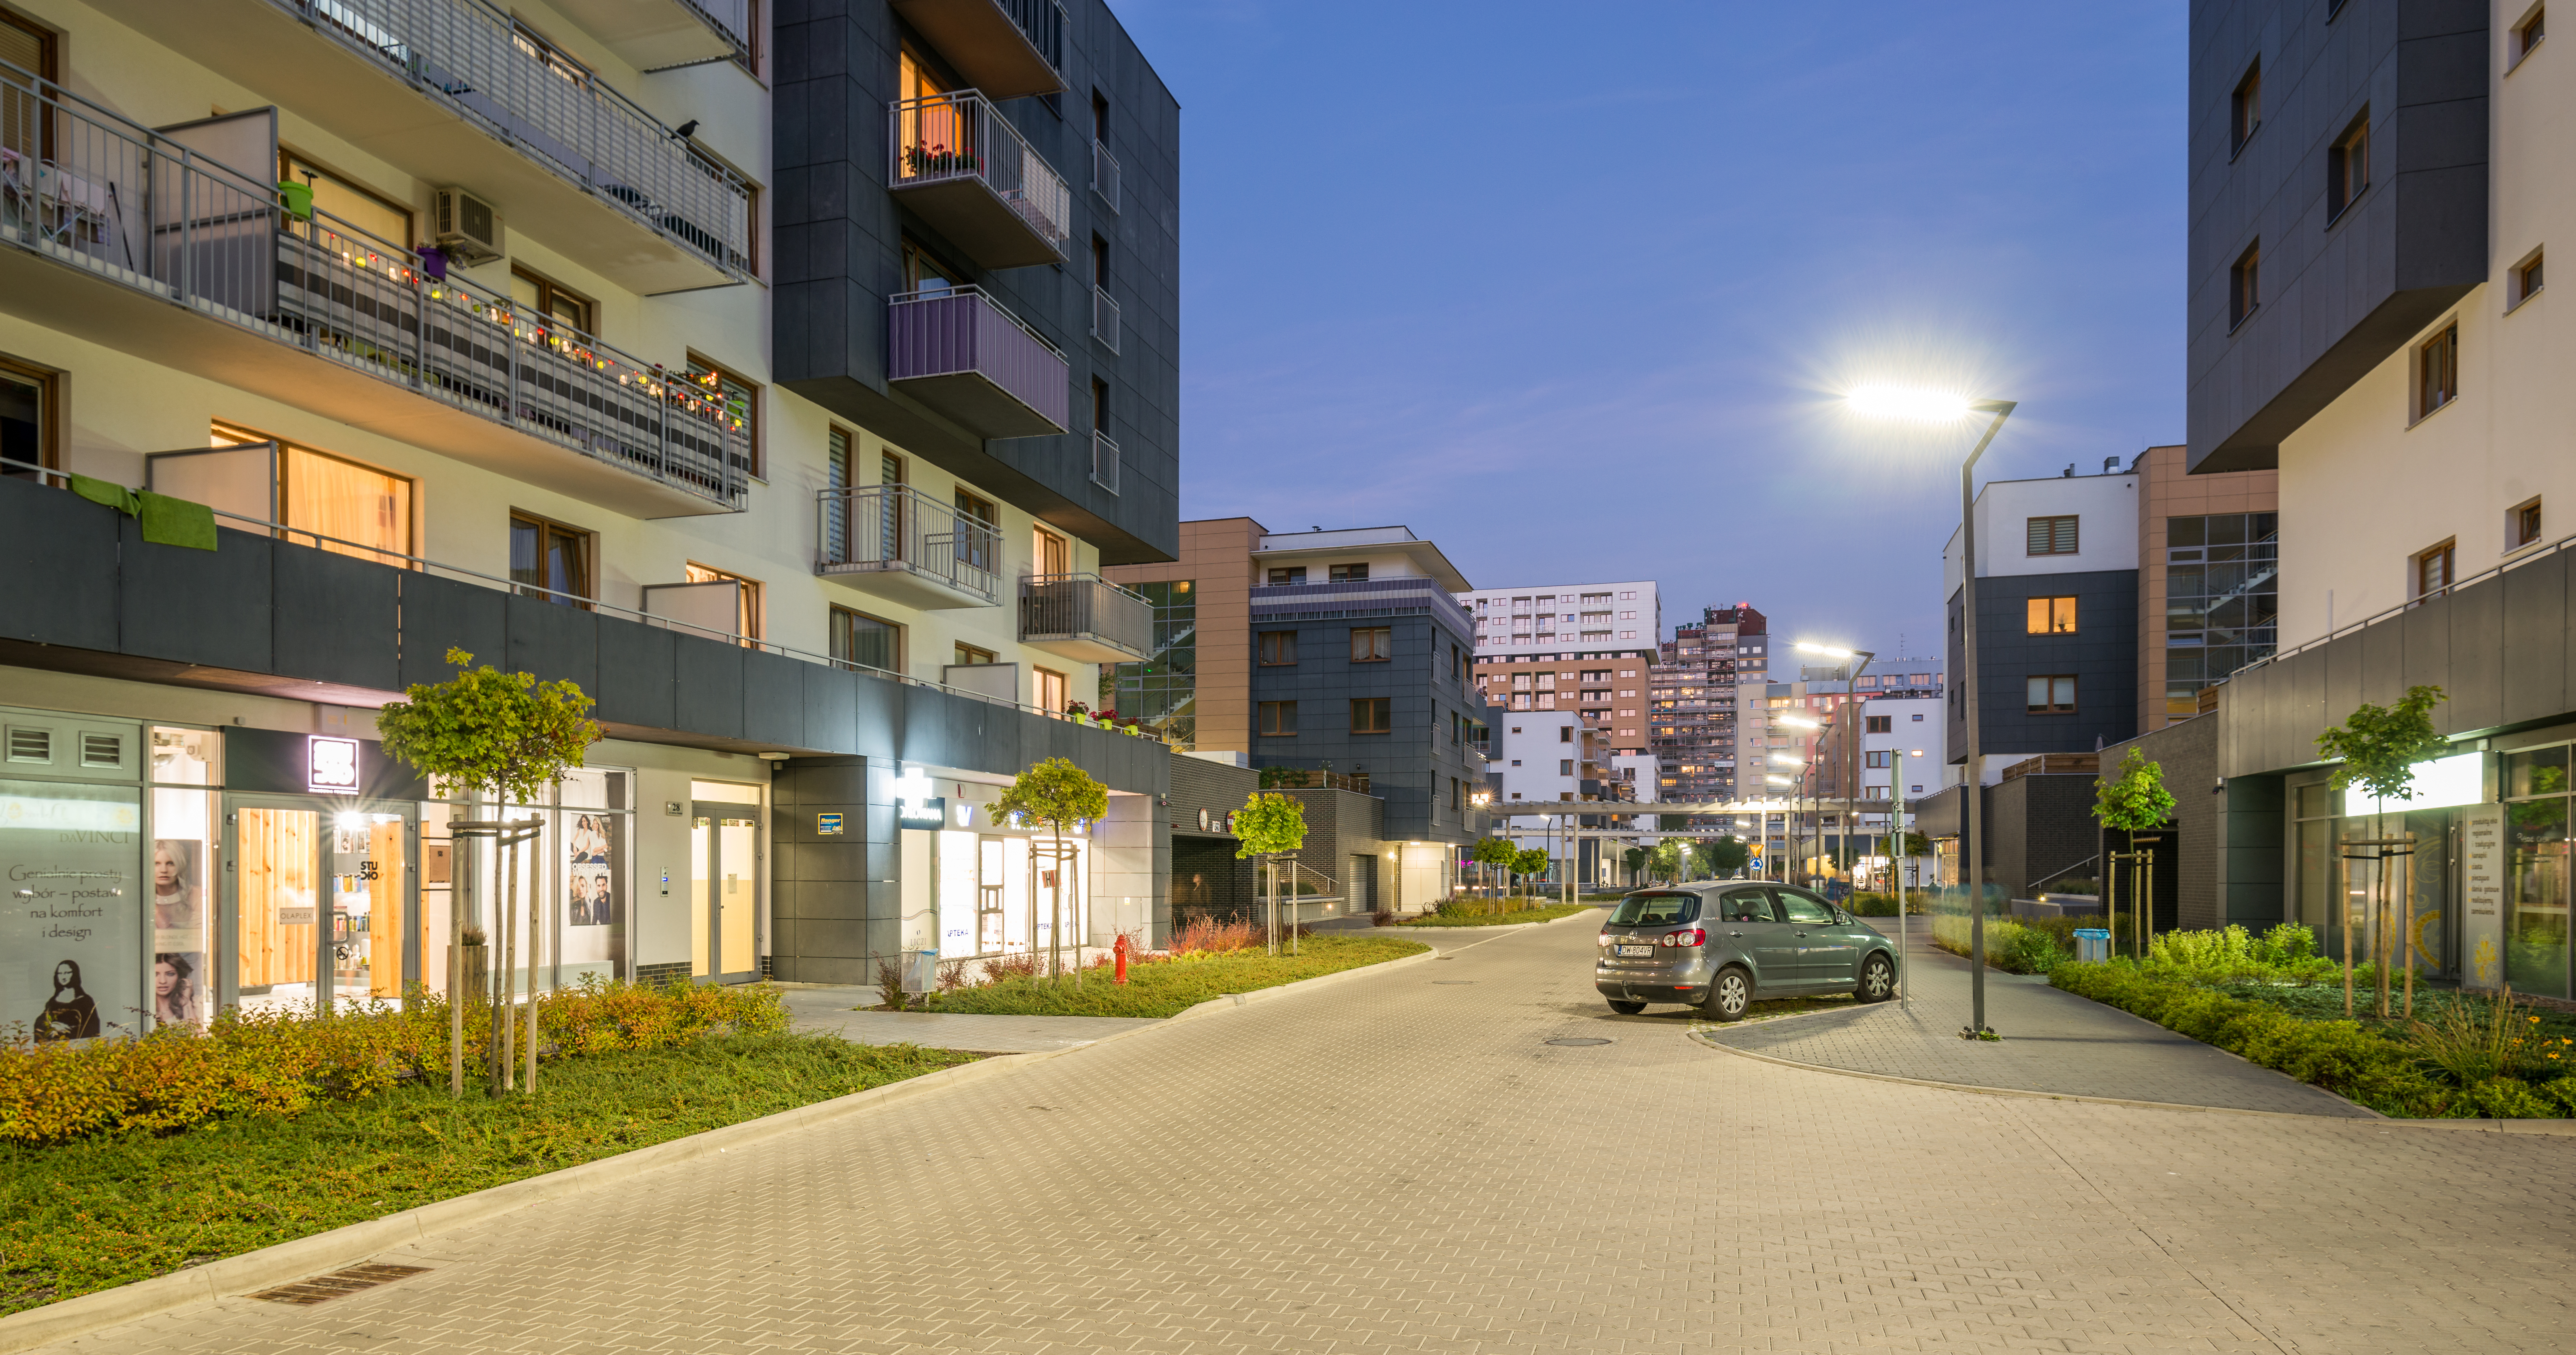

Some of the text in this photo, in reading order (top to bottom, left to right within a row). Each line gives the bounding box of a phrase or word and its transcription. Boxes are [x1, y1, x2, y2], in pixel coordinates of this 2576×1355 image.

[672, 803, 680, 811] 28
[360, 861, 377, 870] STU
[9, 864, 122, 885] Genialnie prosty
[1045, 872, 1051, 886] H
[13, 884, 56, 904] wybór
[72, 888, 121, 904] postaw
[30, 903, 103, 919] na komfort
[42, 924, 92, 941] i design
[911, 938, 927, 946] LICZI
[1632, 946, 1652, 954] 804VR
